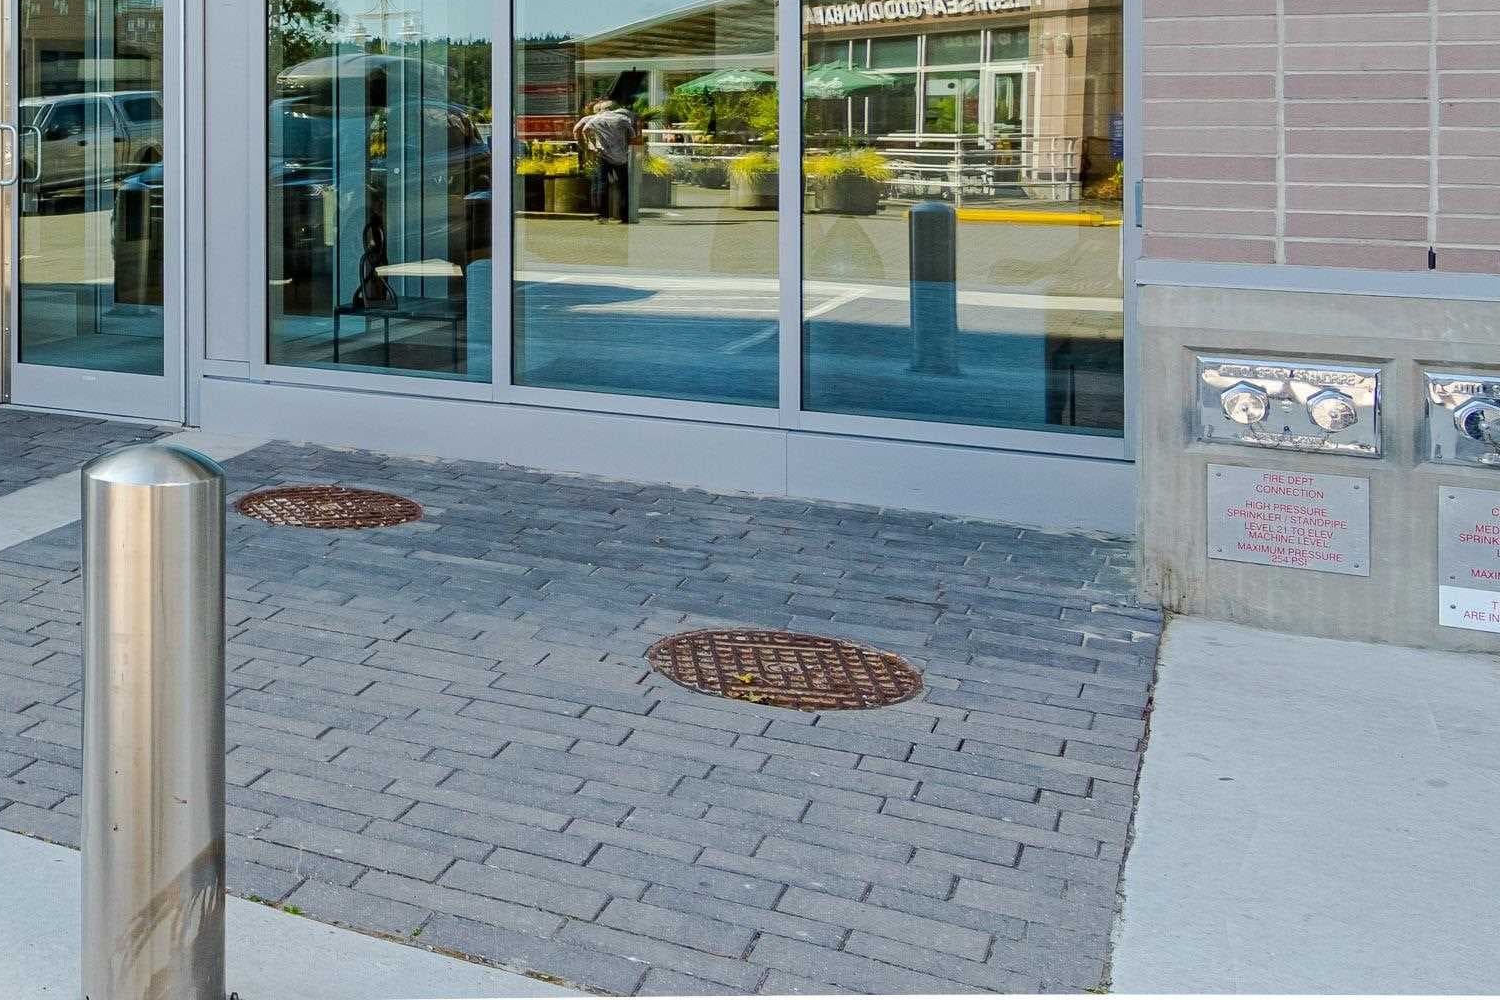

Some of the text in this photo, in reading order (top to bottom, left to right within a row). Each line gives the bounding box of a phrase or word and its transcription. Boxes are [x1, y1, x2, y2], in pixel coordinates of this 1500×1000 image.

[1263, 473, 1315, 486] FIRE DEPT
[1255, 484, 1324, 499] CONNECTION
[1245, 500, 1328, 517] HIGH PRESSURE
[1227, 508, 1281, 522] SPRINKLER
[1290, 516, 1348, 530] STANDPIPE
[1244, 522, 1275, 533] LEVEL
[1291, 527, 1305, 537] TO
[1308, 529, 1334, 539] ELEV
[1248, 531, 1295, 544] MACHINE
[1237, 542, 1344, 563] MAXIMUM PRESSURE
[1271, 554, 1307, 567] 254 PSI
[1463, 610, 1485, 621] ARE
